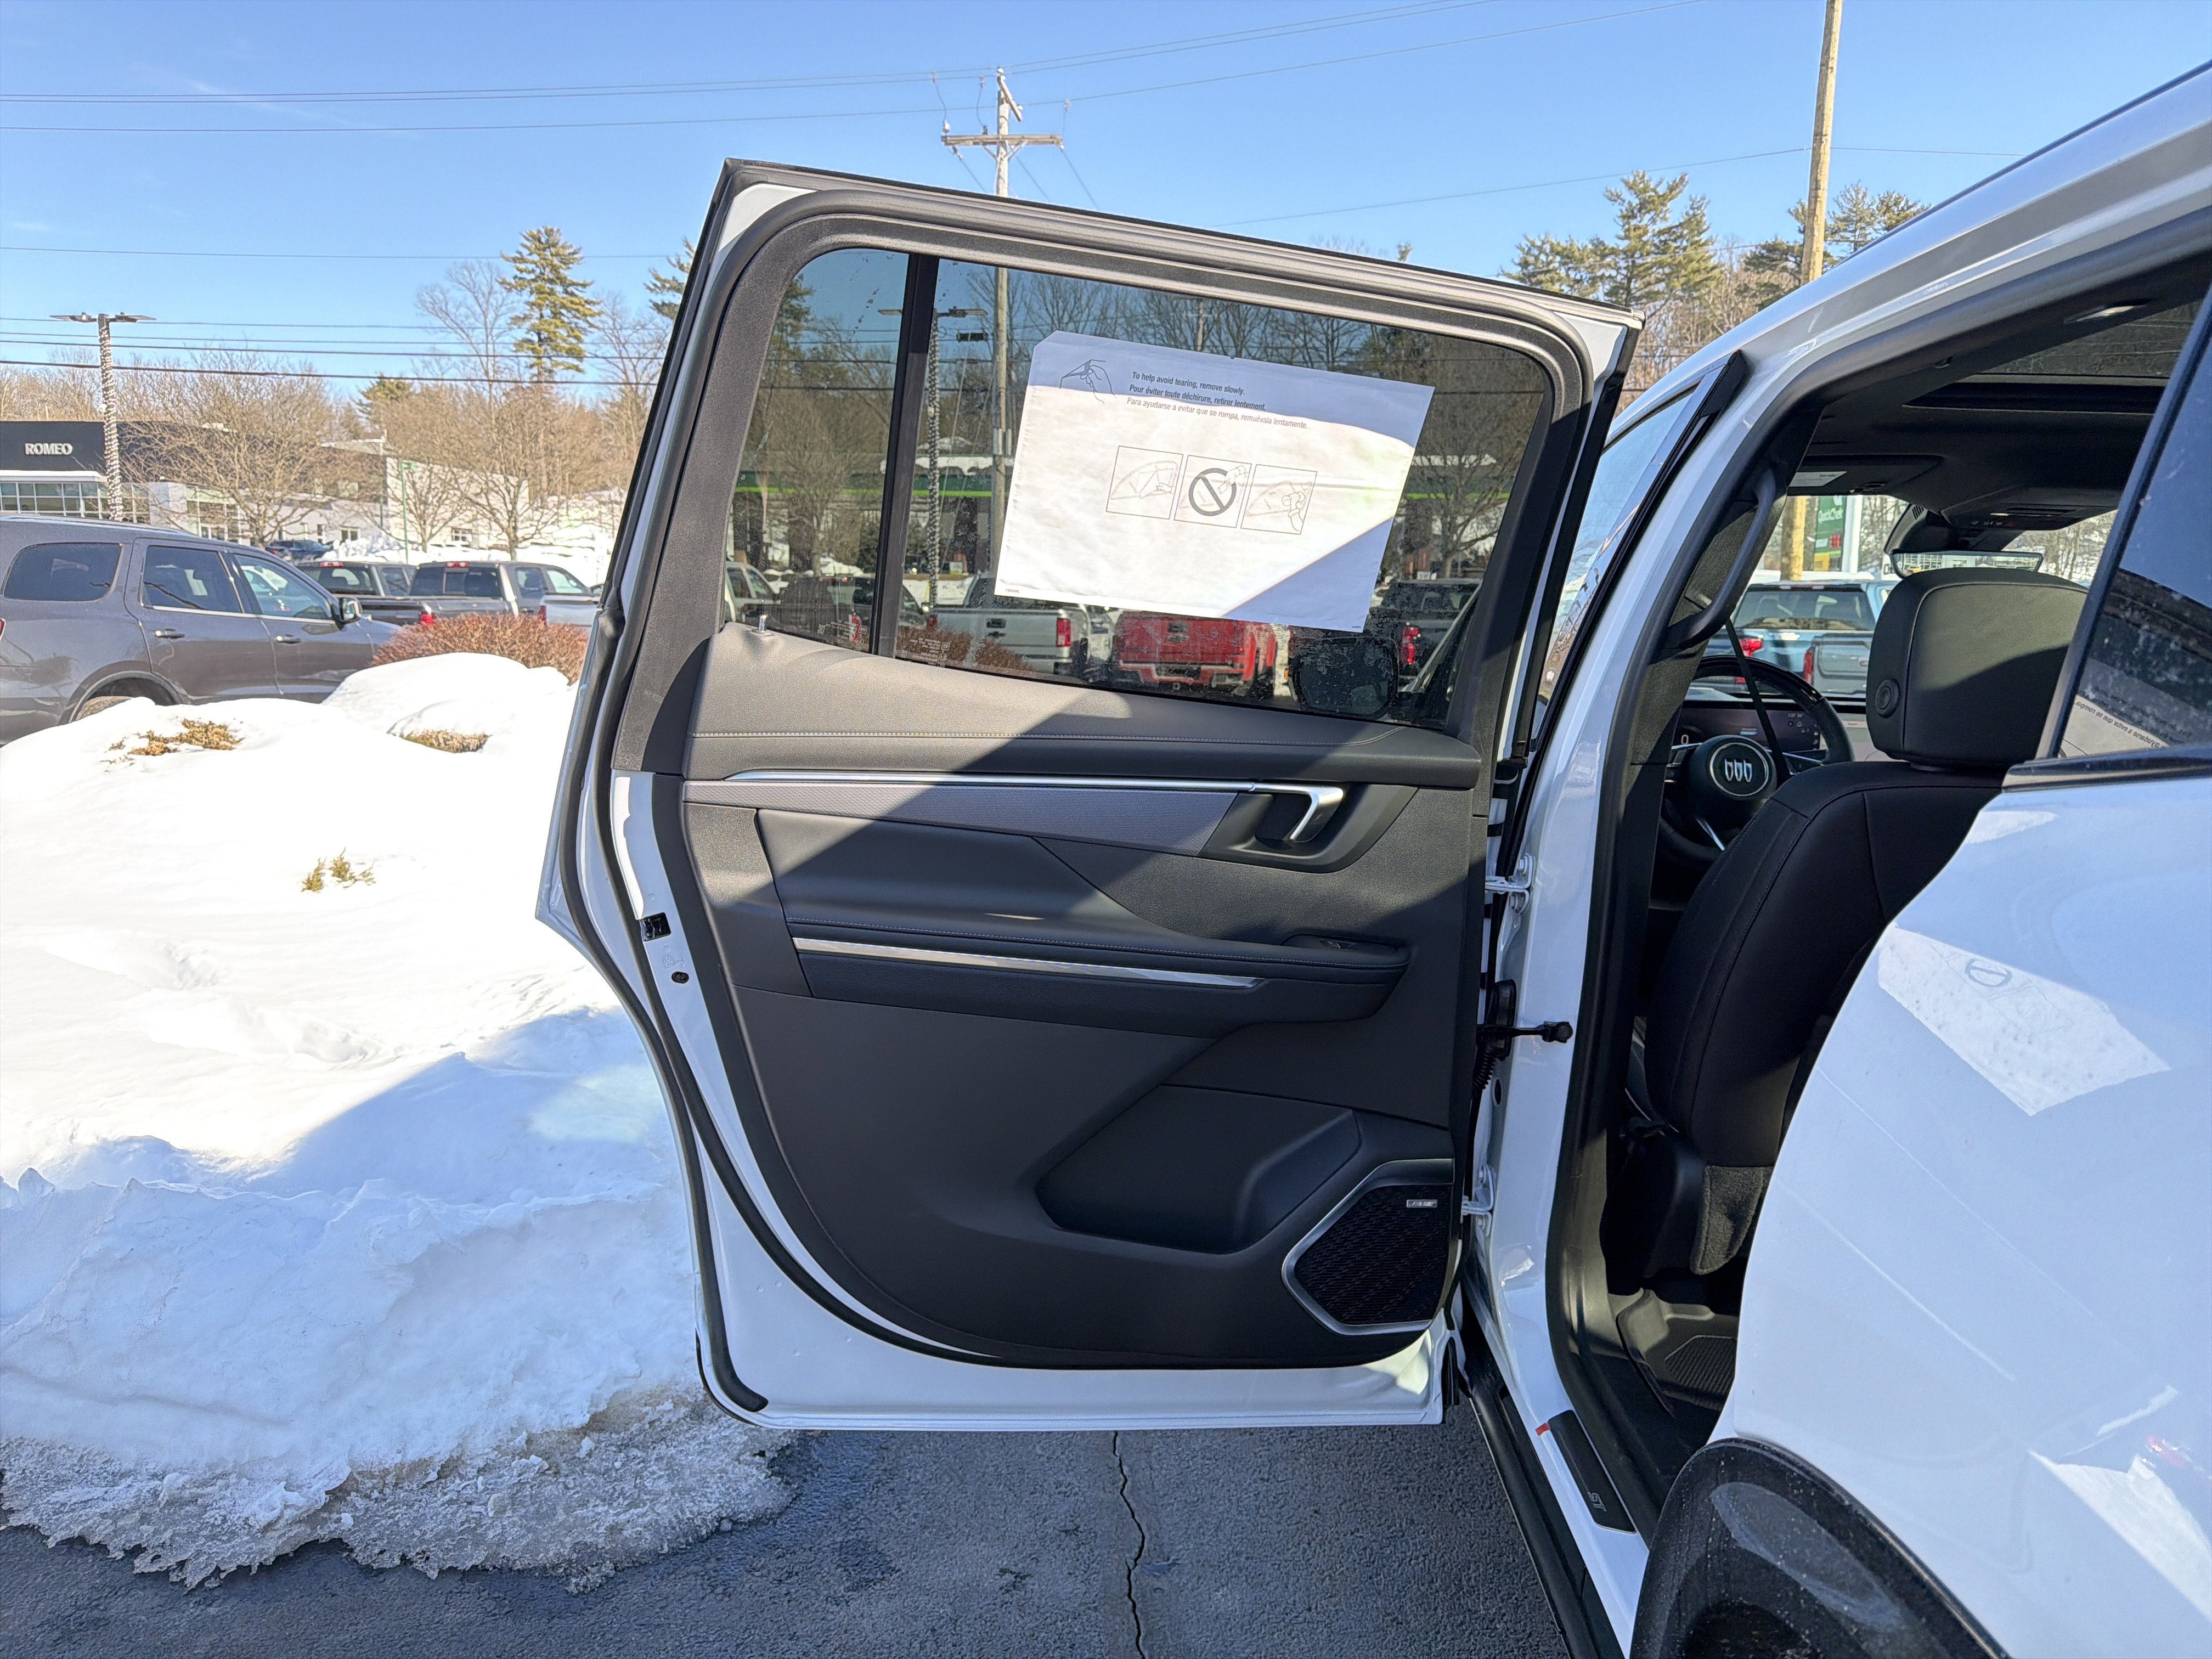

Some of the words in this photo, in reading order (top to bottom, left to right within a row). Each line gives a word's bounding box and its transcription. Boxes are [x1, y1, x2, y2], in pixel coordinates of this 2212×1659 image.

[1141, 373, 1155, 383] help
[1156, 376, 1174, 385] avoid
[1175, 378, 1198, 389] tearing,
[1199, 383, 1222, 392] remove
[1223, 385, 1245, 396] slowly.
[1129, 385, 1144, 393] Pour
[1146, 386, 1164, 396] éviter
[1165, 390, 1180, 398] toute
[1182, 392, 1212, 404] déchirure,
[1214, 397, 1233, 407] retirer
[1234, 399, 1266, 411] lentement.
[1127, 397, 1141, 406] Para
[1143, 400, 1171, 410] ayudarse
[1177, 405, 1195, 413] evitar
[1218, 411, 1239, 421] rompa,
[1241, 414, 1272, 424] remuévala
[1273, 418, 1308, 429] lentamente.
[25, 443, 73, 455] ROMEO
